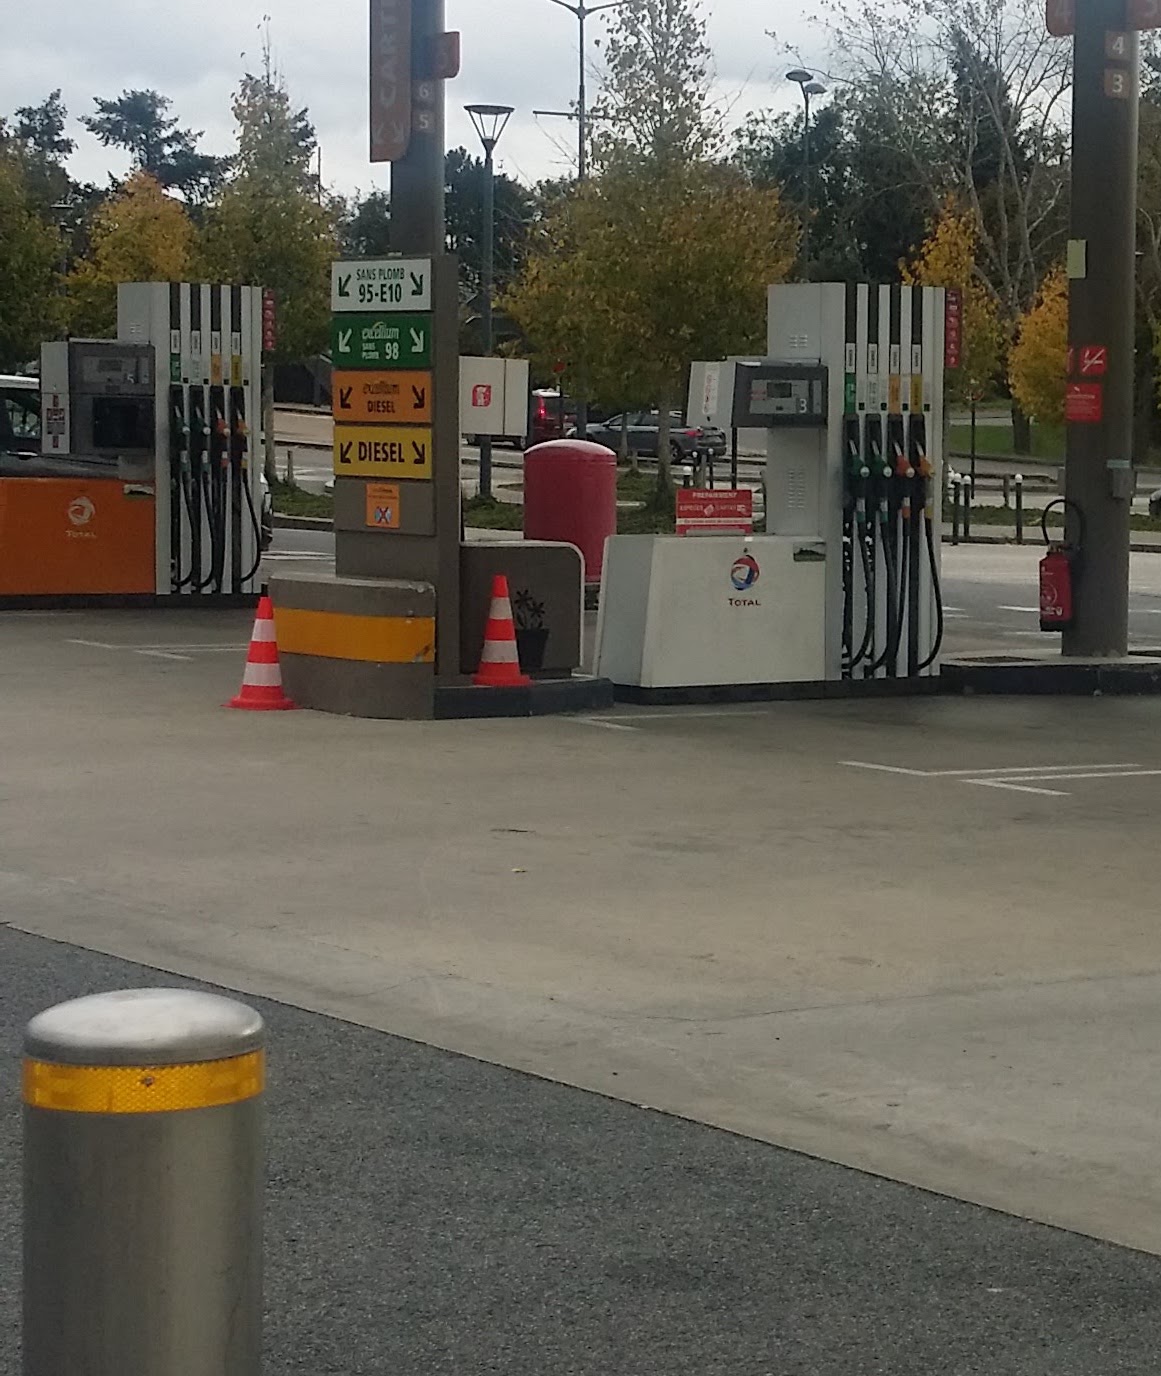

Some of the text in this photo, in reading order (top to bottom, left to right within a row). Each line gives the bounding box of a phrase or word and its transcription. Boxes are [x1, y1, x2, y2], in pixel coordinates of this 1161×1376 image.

[1112, 36, 1124, 54] 4
[1112, 74, 1124, 93] 3
[418, 84, 430, 99] 6
[418, 114, 430, 129] 5
[356, 267, 405, 281] SANS PLOMB
[359, 283, 402, 303] 95-E10
[385, 342, 399, 360] 98
[367, 400, 396, 414] DIESEL
[799, 398, 807, 413] 3
[358, 441, 405, 463] DIESEL
[728, 598, 762, 607] TOTAL
